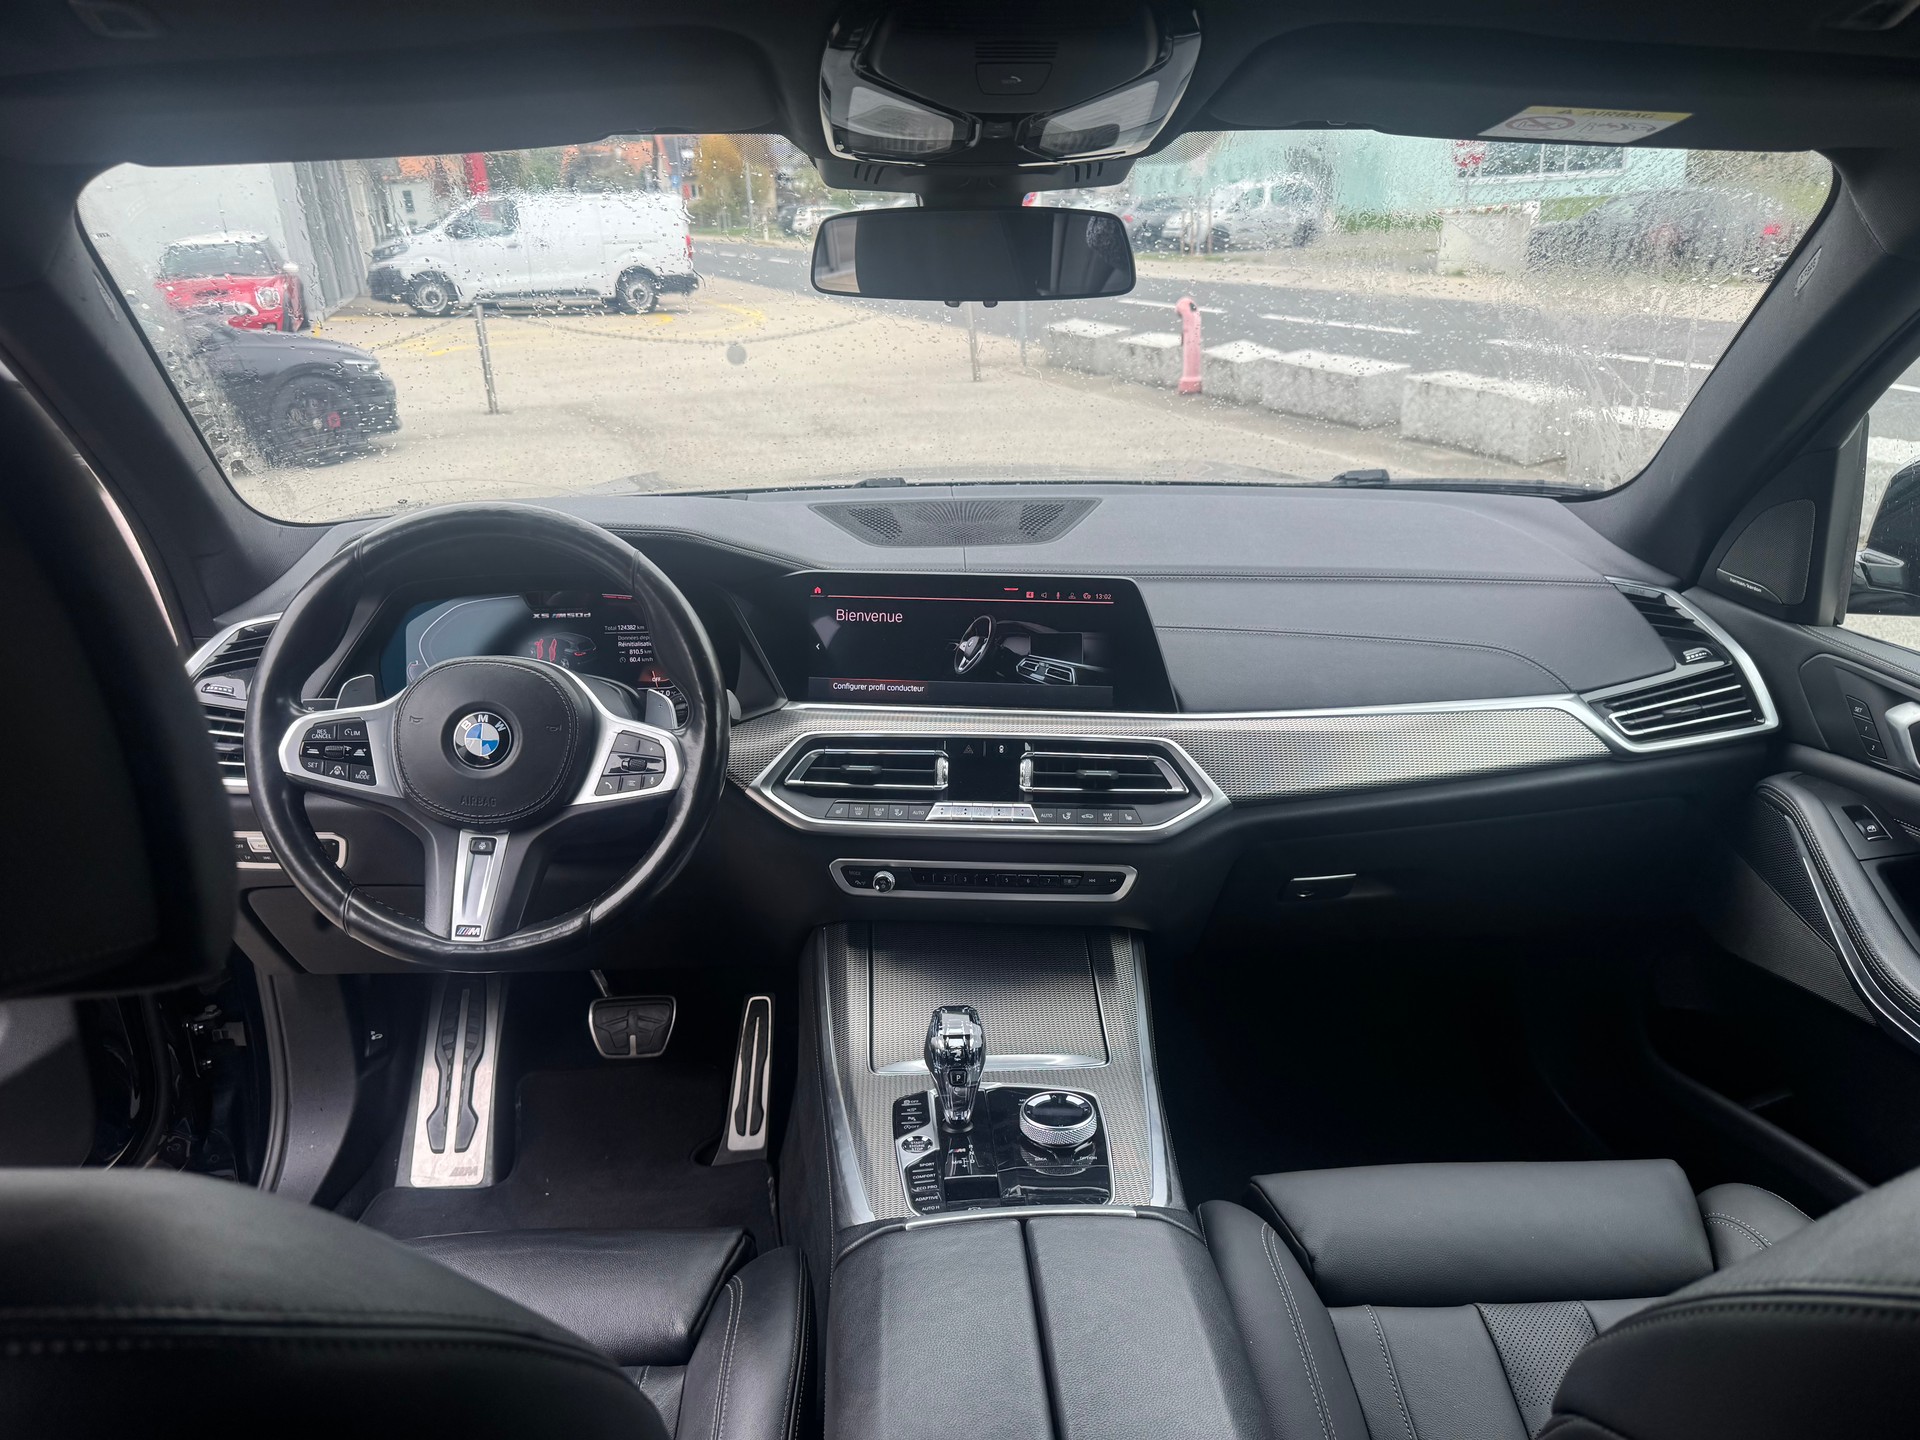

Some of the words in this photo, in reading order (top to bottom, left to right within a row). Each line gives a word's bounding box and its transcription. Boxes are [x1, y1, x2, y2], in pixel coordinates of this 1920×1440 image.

[835, 608, 903, 623] Bienvenue
[832, 682, 867, 692] Configurer
[868, 684, 886, 692] profil
[886, 684, 925, 693] conducteur
[460, 714, 507, 732] BMW
[460, 796, 497, 808] AIRBAG
[956, 1074, 962, 1082] P
